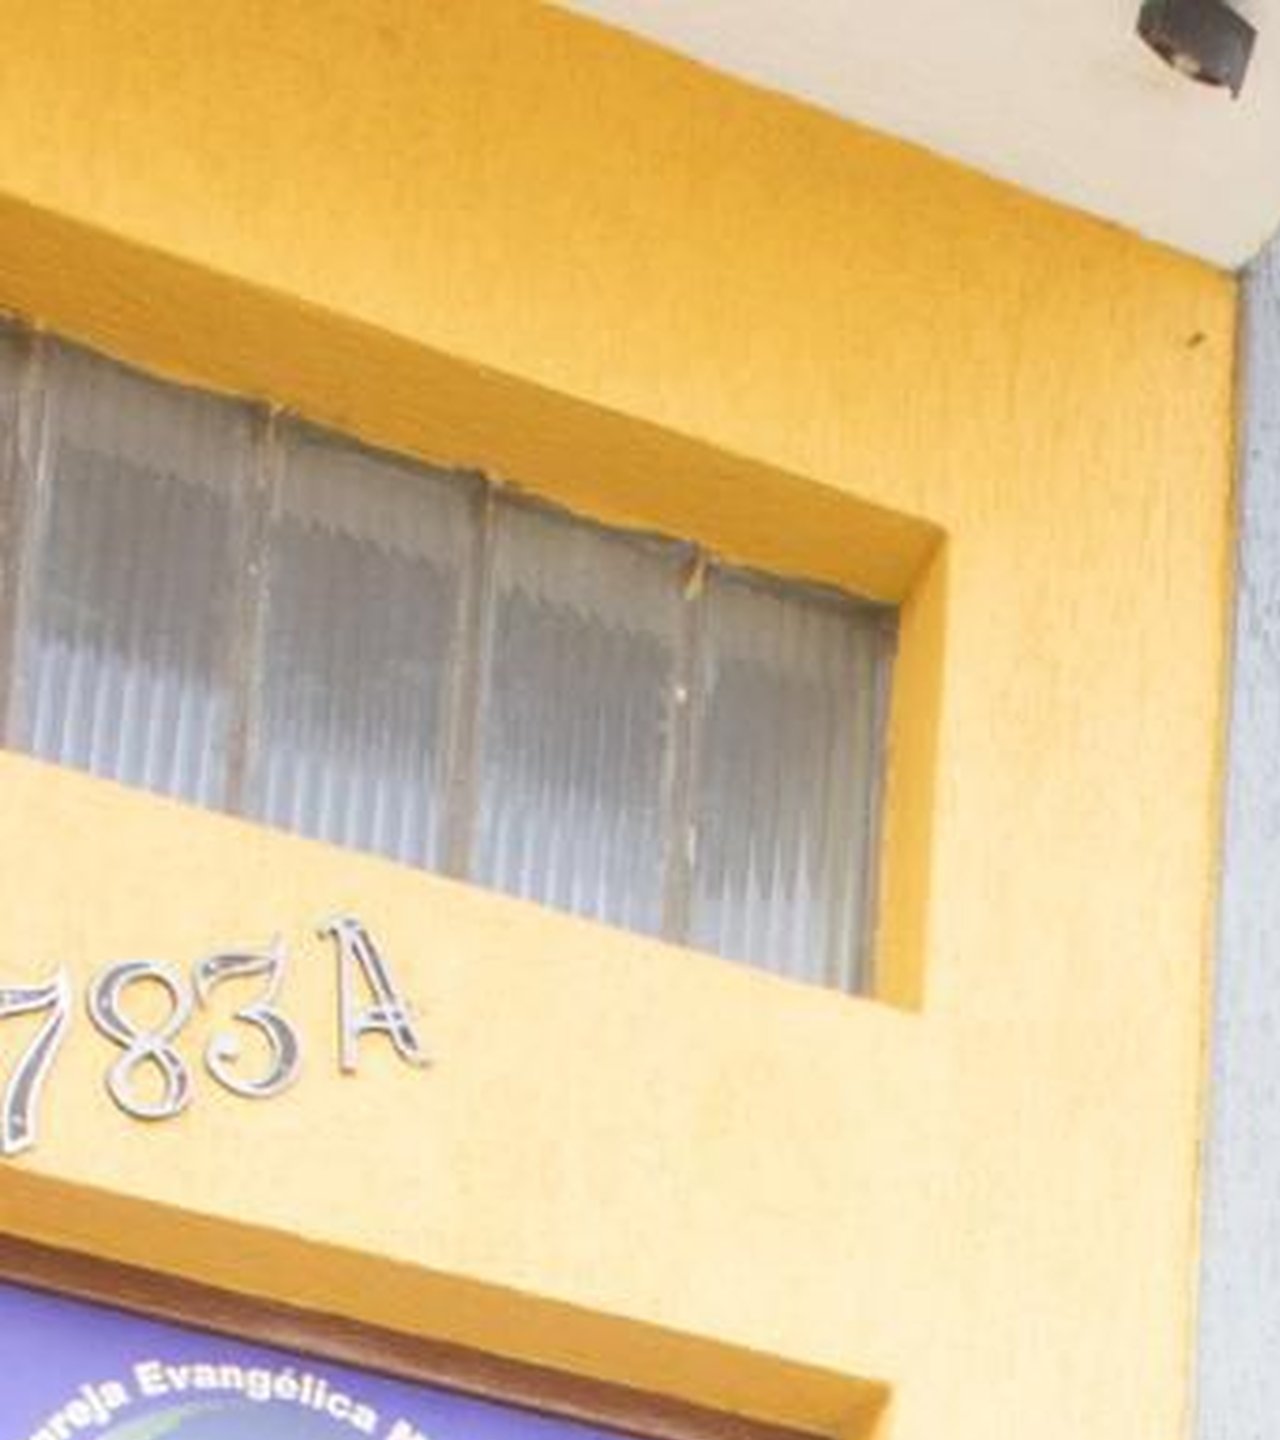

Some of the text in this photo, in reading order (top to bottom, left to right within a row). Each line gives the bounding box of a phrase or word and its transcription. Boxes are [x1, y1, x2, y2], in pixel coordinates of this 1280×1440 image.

[0, 917, 434, 1156] 783 A
[133, 1360, 379, 1436] Evangélica
